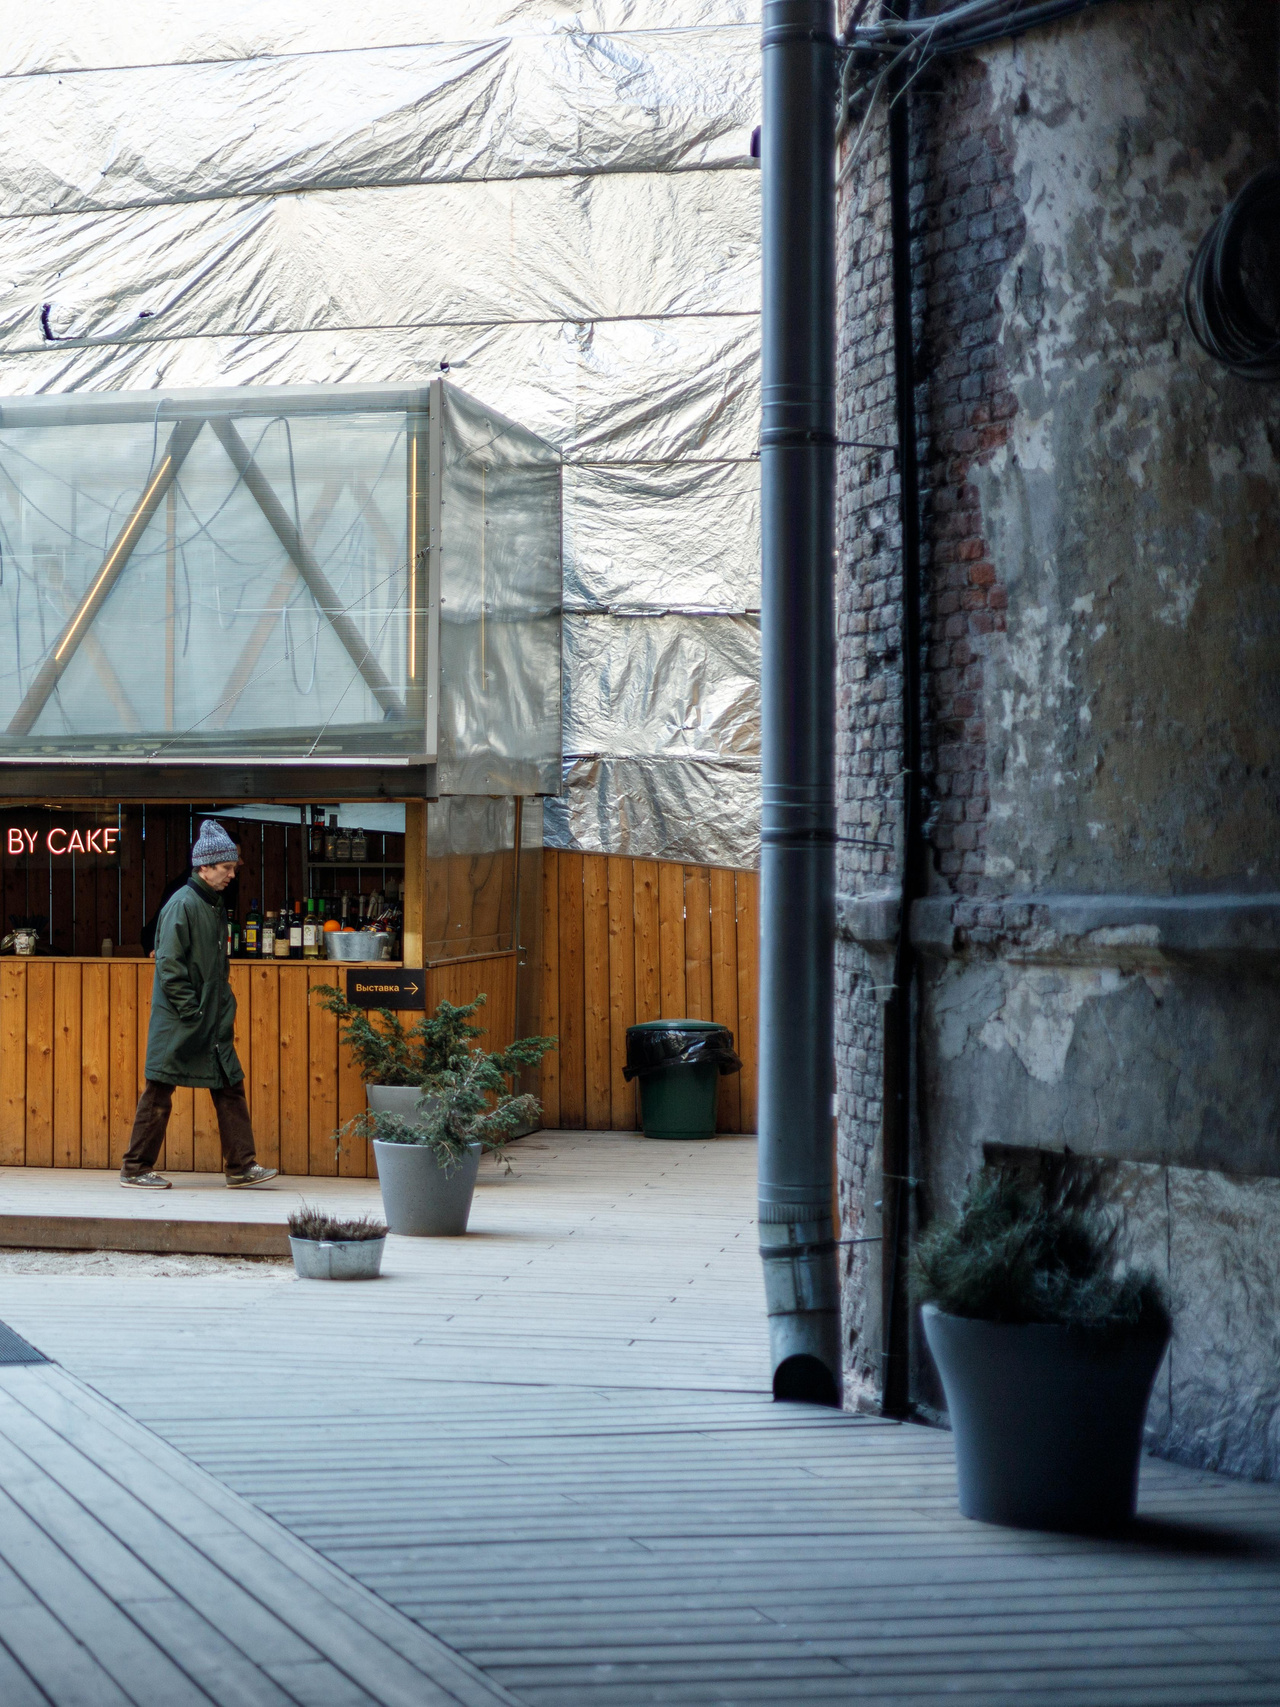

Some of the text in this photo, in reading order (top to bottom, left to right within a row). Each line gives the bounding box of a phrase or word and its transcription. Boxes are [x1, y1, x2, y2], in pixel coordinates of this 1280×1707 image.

[8, 828, 38, 854] BY
[46, 828, 119, 854] CAKE
[355, 983, 400, 992] Выставка
